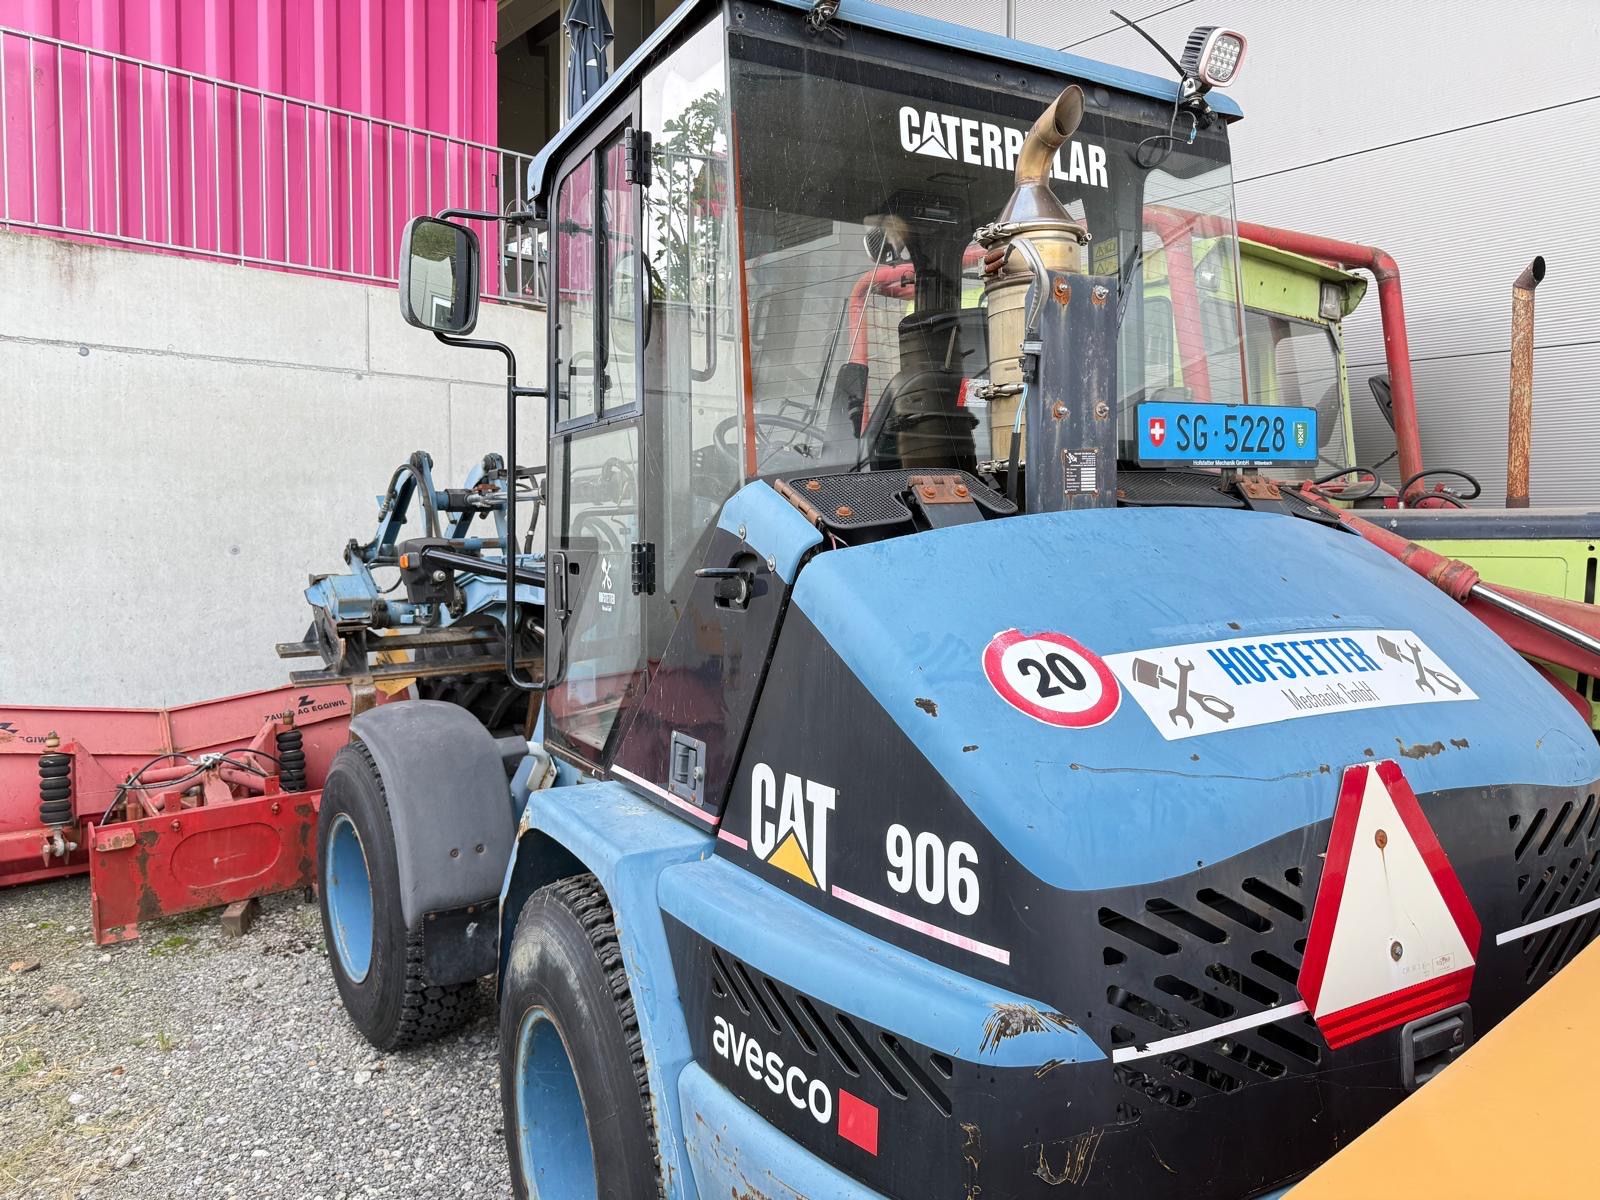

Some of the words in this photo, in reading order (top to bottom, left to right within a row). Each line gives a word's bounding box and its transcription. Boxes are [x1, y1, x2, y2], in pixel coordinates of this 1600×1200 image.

[899, 105, 1109, 189] CATERPLAR
[1017, 652, 1087, 698] 20
[1207, 637, 1383, 686] HOFSTETTER
[298, 707, 310, 716] AG
[1281, 684, 1347, 711] Mechanik
[1337, 680, 1380, 704] GmbH
[751, 762, 836, 893] CAT
[885, 823, 980, 916] 906
[712, 1015, 833, 1124] avesco
